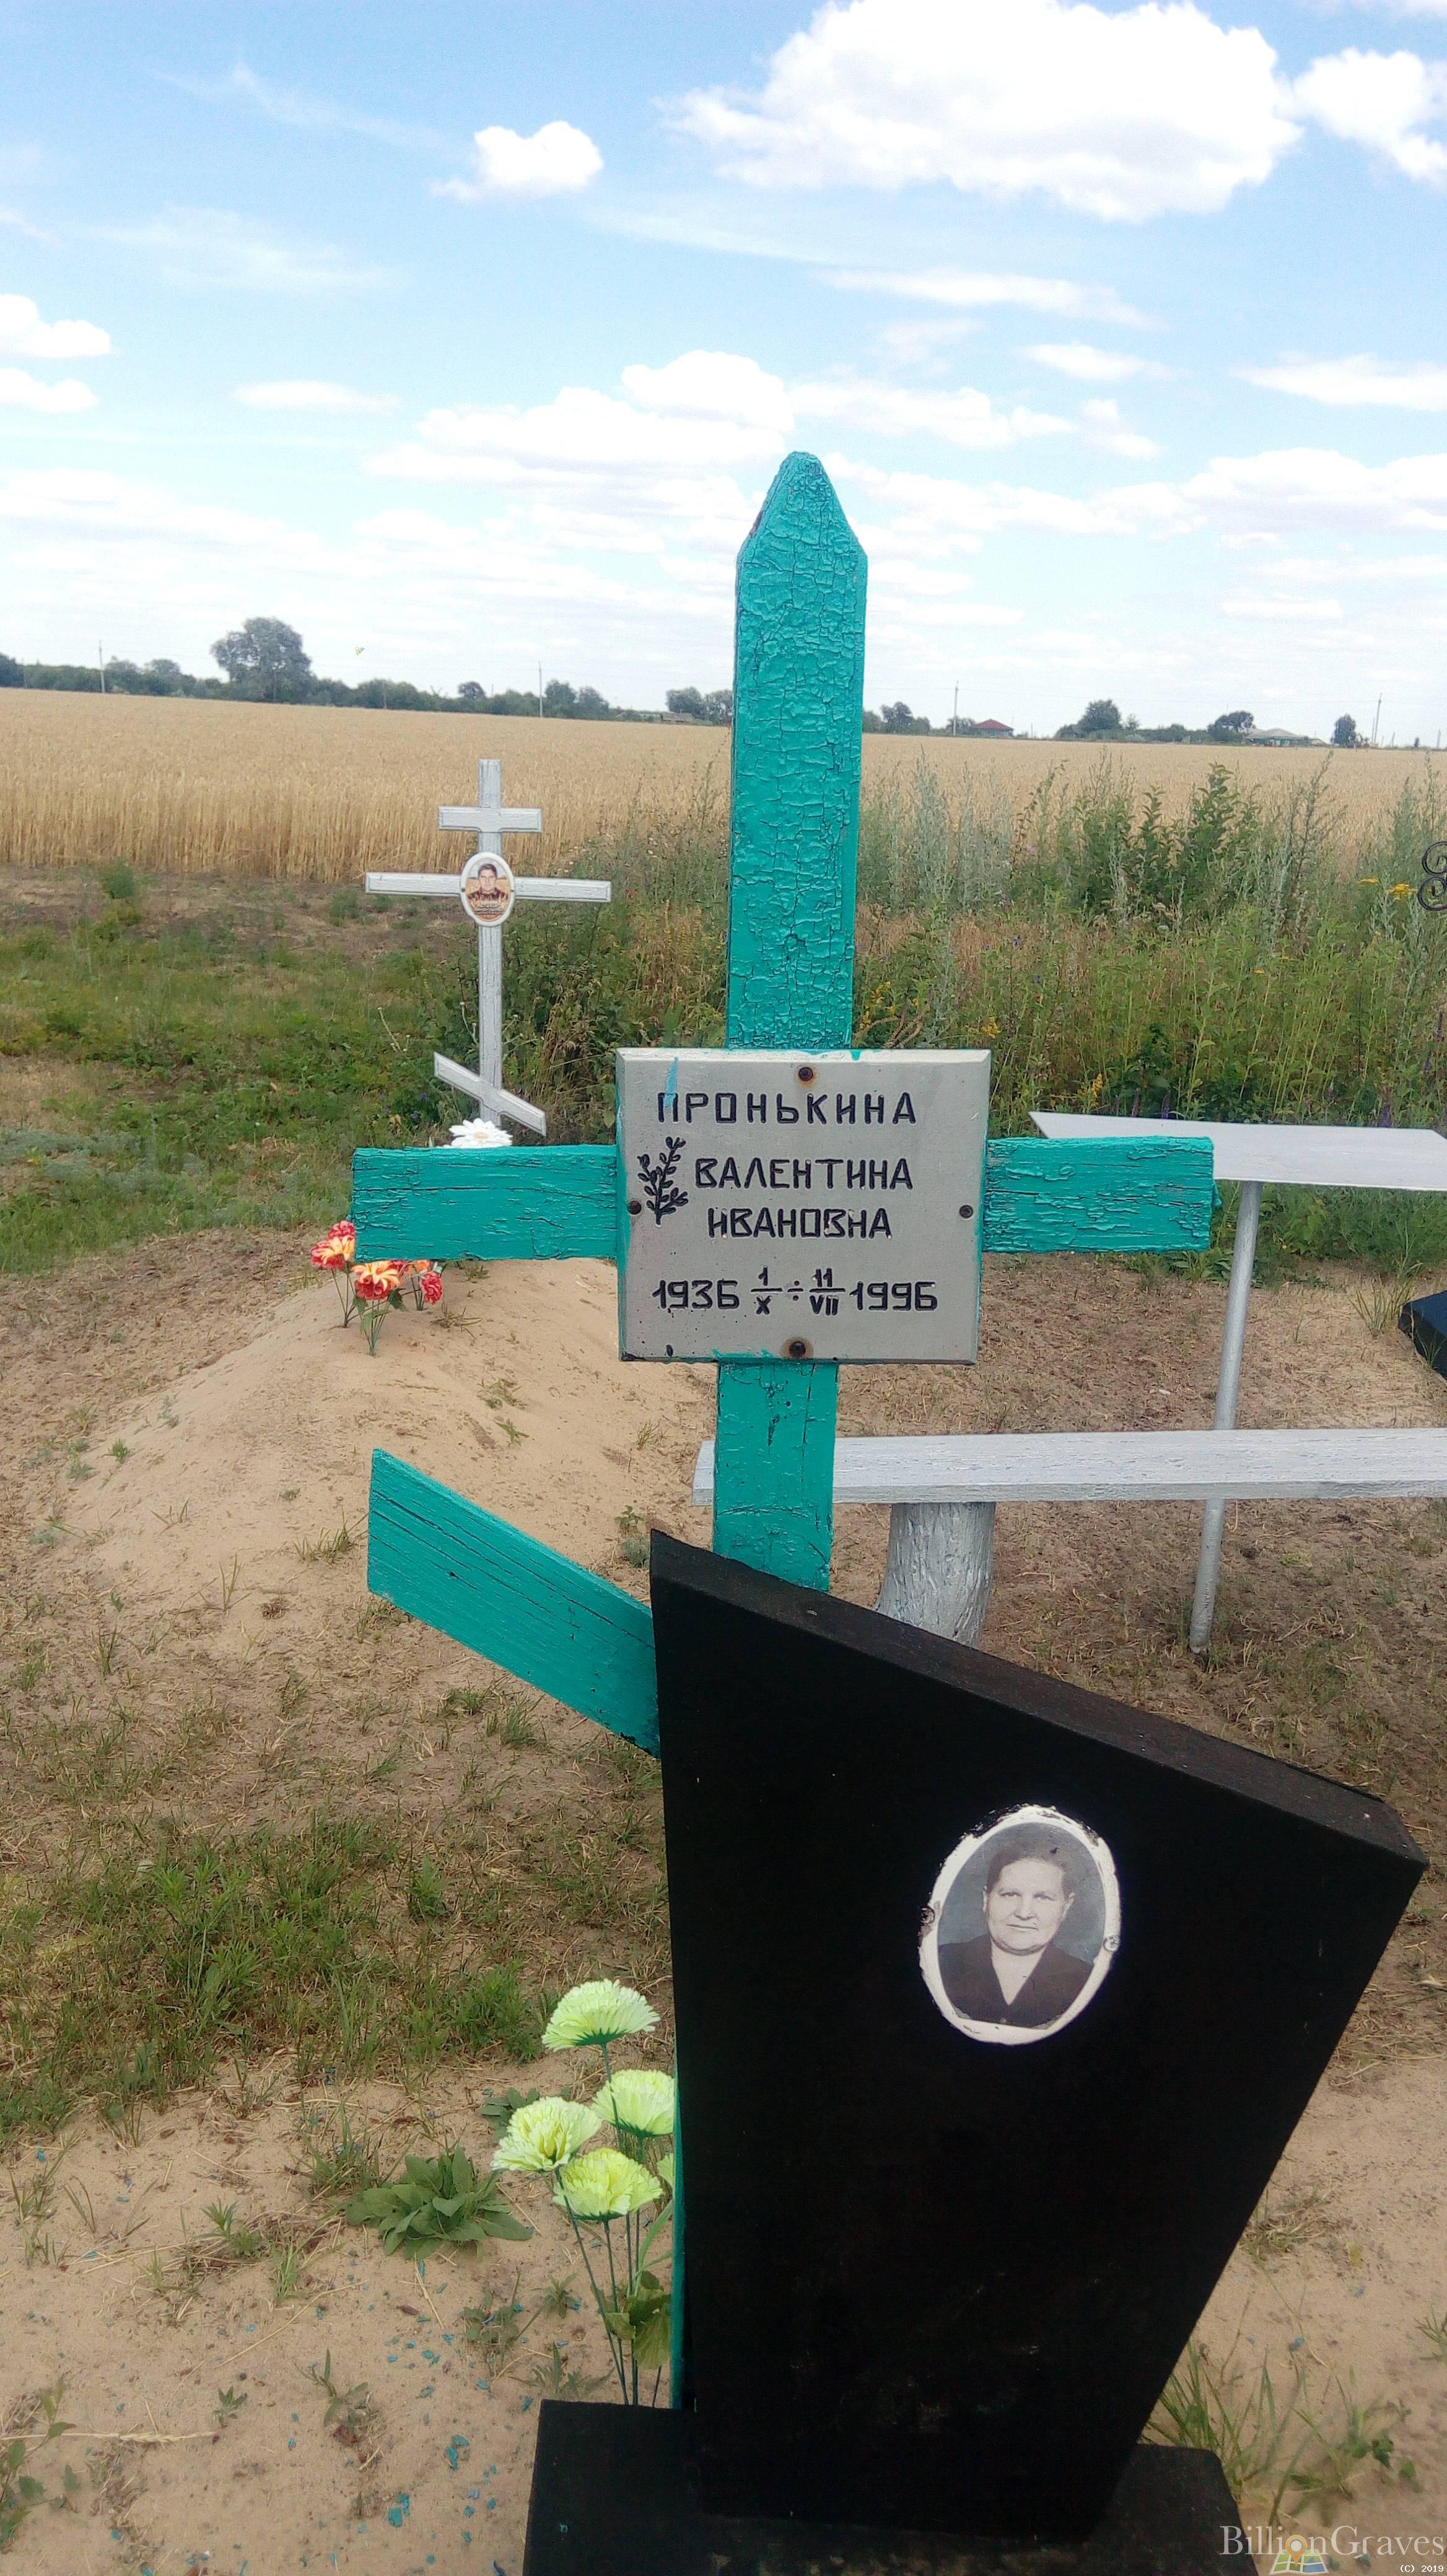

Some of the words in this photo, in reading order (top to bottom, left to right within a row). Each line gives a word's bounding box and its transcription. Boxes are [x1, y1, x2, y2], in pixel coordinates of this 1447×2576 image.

[657, 1092, 917, 1125] ПРОНЬКИНА
[694, 1157, 914, 1190] ВАЛЕНТИНА
[708, 1208, 892, 1238] ИВАНОВНА
[652, 1279, 740, 1310] 1936
[849, 1281, 938, 1311] 1996
